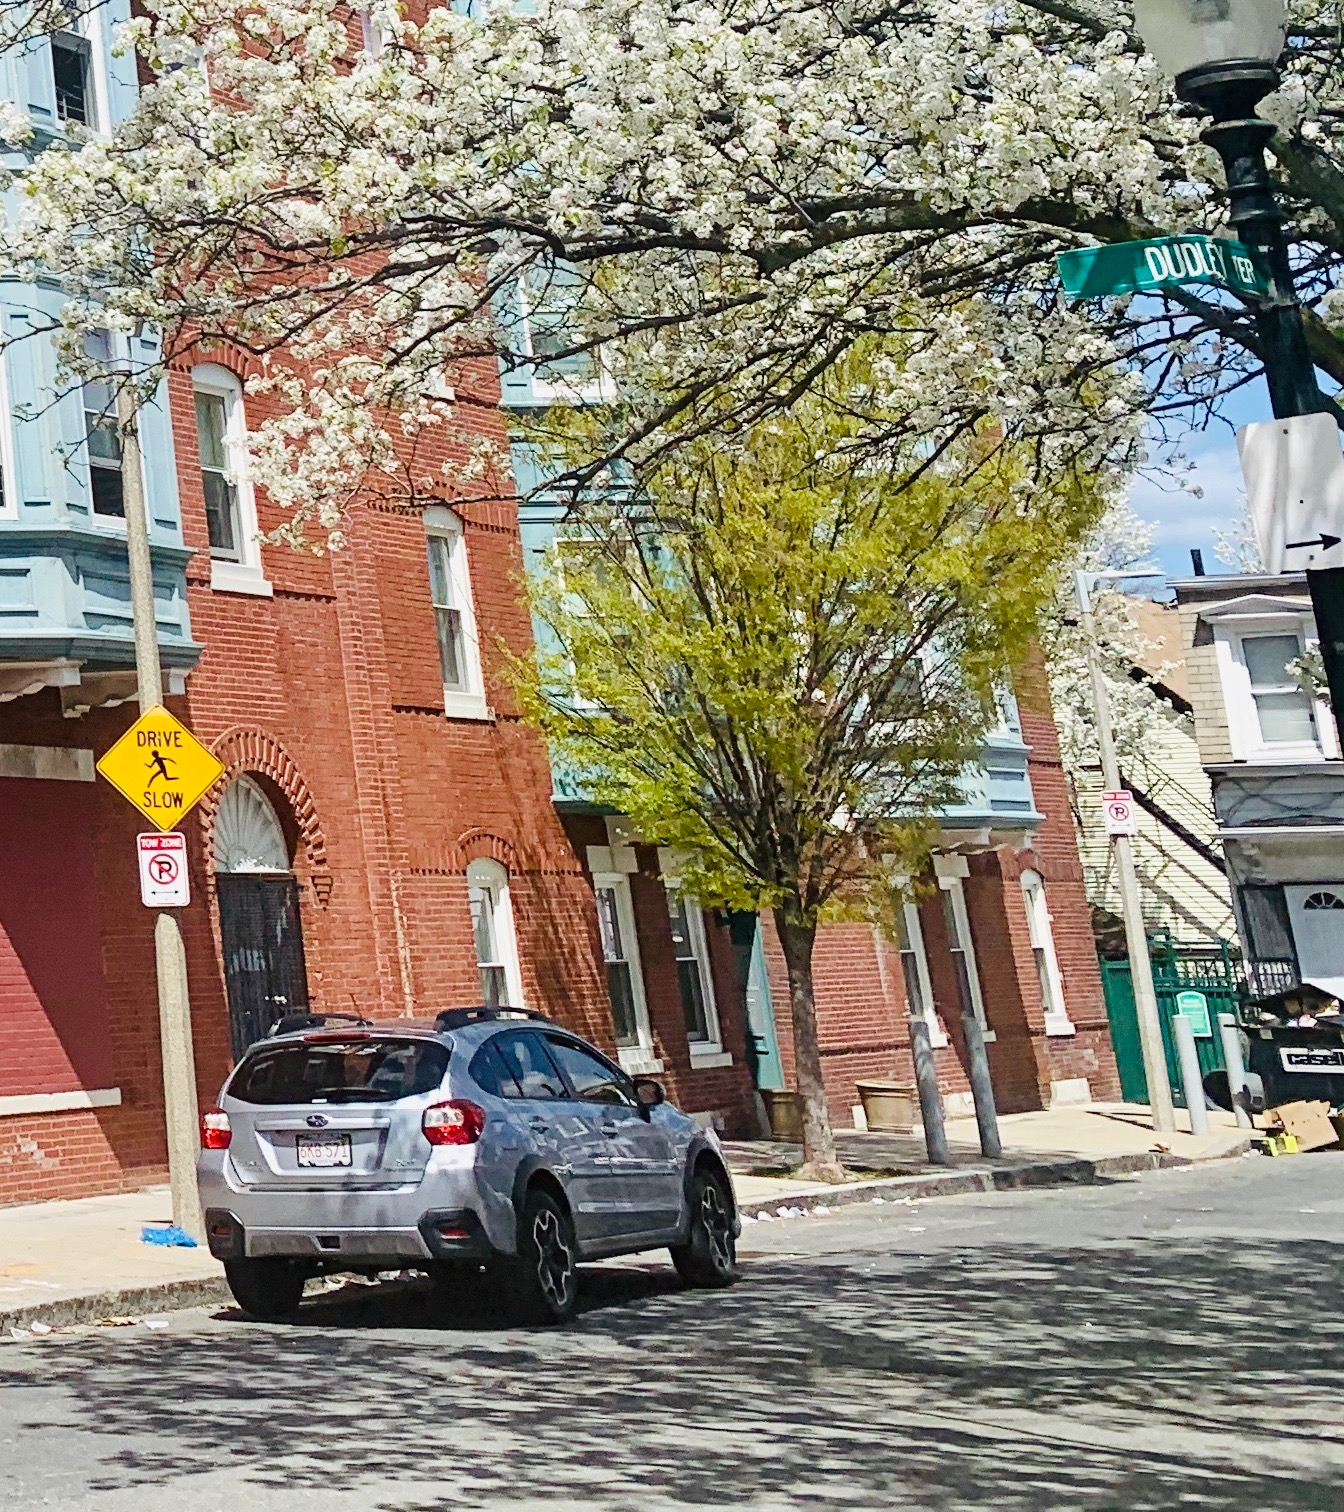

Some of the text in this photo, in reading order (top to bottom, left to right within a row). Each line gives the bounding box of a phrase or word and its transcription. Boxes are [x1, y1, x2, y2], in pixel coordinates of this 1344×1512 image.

[1144, 242, 1256, 283] DUDLEY TER
[137, 731, 183, 748] DRIVE
[143, 791, 184, 808] SLOW
[141, 837, 183, 848] TOW ZONE
